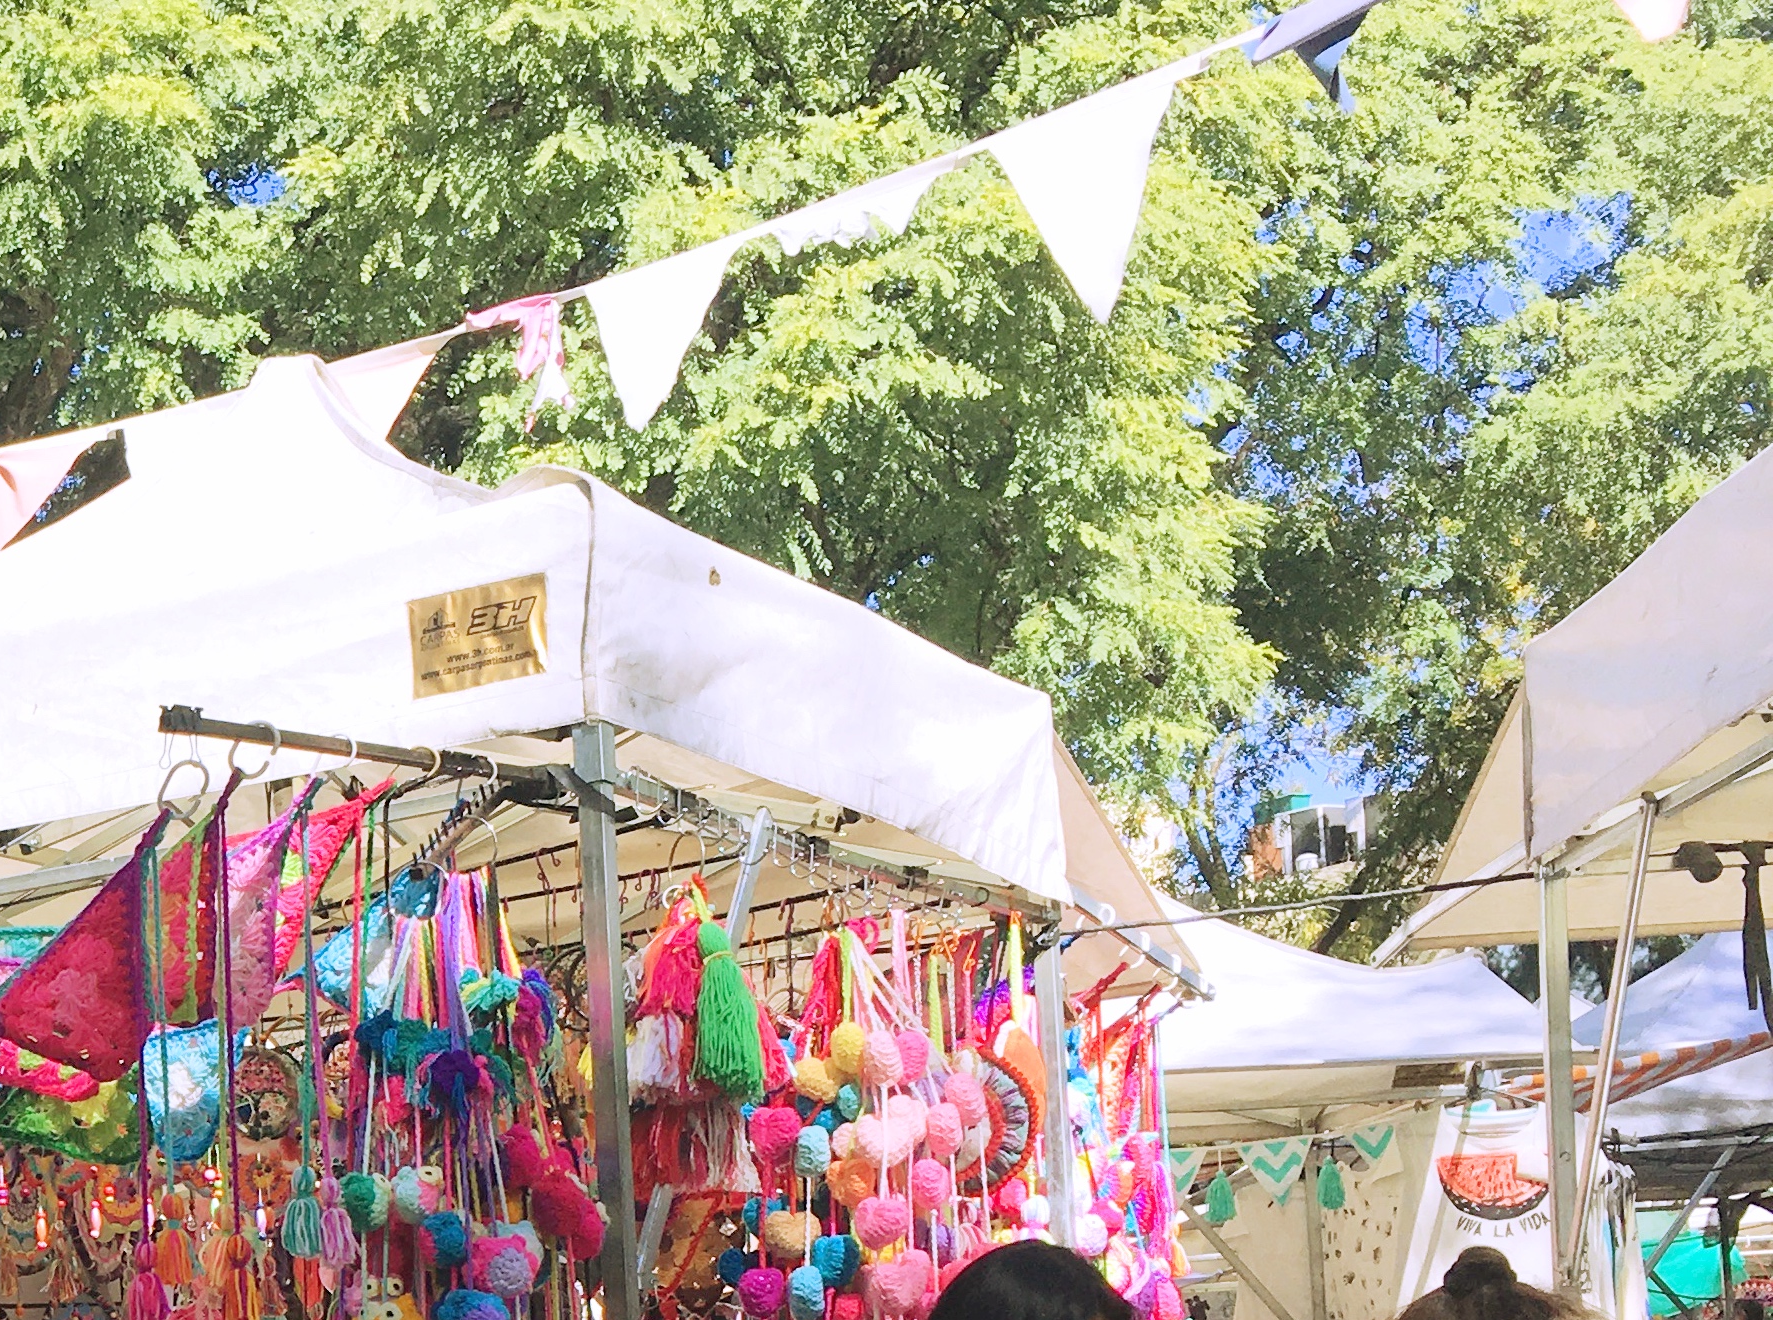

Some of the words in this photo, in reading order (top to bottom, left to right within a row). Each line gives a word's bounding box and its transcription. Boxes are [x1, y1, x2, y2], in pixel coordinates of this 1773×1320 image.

[1455, 1215, 1482, 1236] VIVA
[1493, 1222, 1514, 1238] LA
[1519, 1211, 1551, 1234] VIDA
